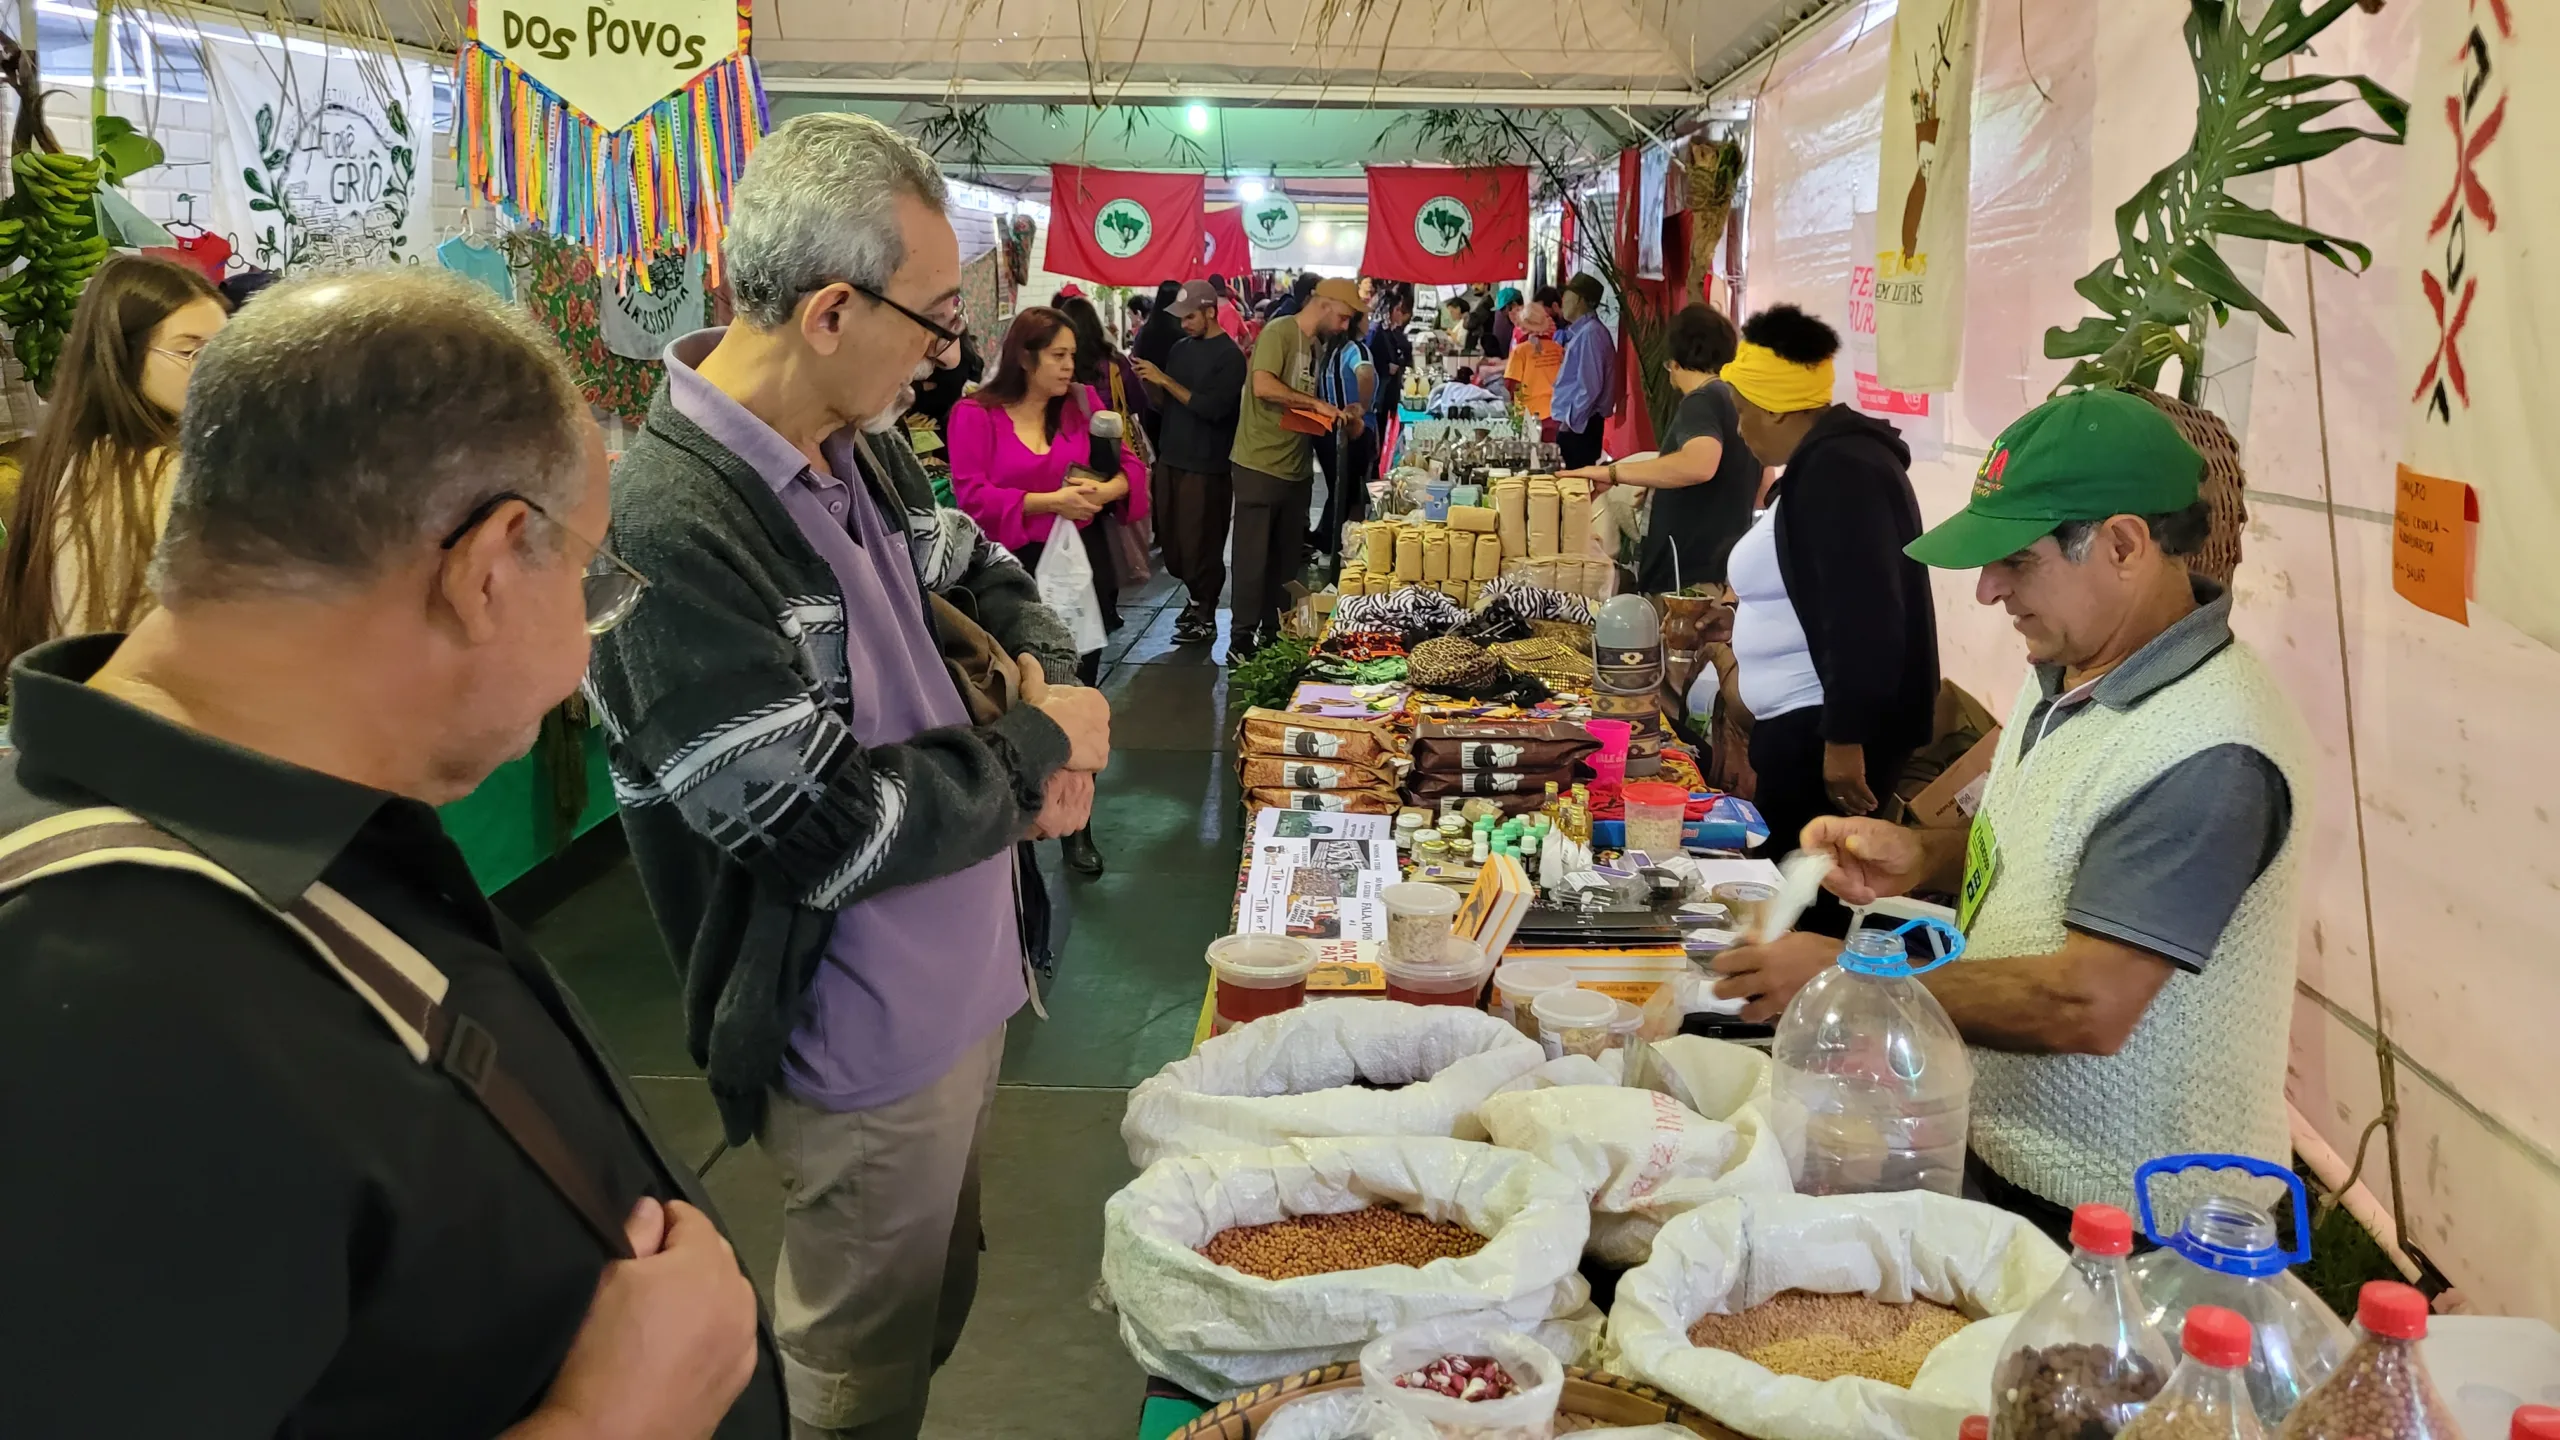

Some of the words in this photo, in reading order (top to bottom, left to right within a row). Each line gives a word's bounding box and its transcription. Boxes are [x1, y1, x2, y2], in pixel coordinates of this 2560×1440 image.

[503, 10, 577, 60] DOS
[587, 6, 706, 70] POVOS
[1850, 266, 1875, 297] FE
[1361, 902, 1372, 922] FALA,
[1320, 945, 1339, 963] PAT
